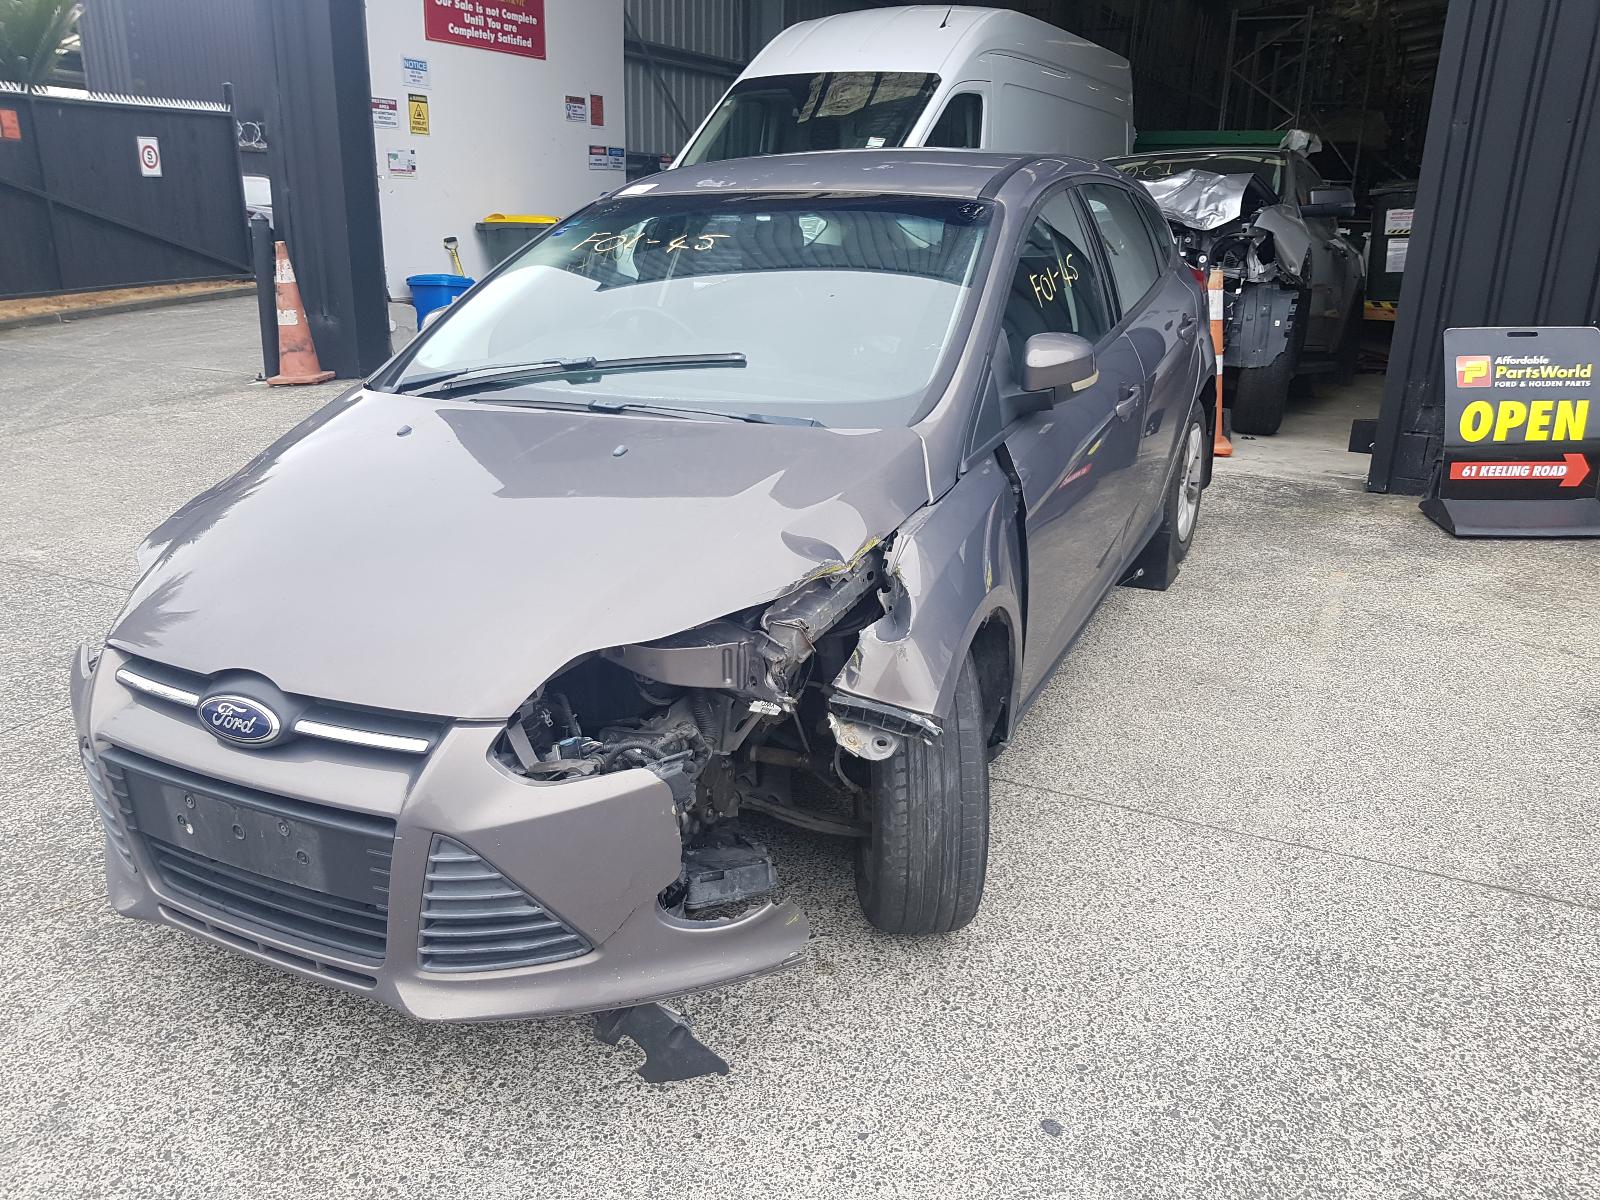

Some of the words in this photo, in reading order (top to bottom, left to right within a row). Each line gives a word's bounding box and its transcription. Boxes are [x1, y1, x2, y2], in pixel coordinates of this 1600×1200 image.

[454, 0, 474, 11] Sale
[476, 2, 483, 13] is
[486, 7, 499, 16] not
[501, 8, 538, 25] Complete
[463, 13, 484, 26] Until
[486, 17, 501, 29] You
[503, 22, 517, 33] are
[447, 22, 496, 43] Completely
[497, 32, 533, 48] Satisfied
[404, 60, 427, 70] NOTICE
[146, 150, 153, 160] 5
[1494, 355, 1550, 365] Affordable
[1495, 363, 1593, 379] PartsWorld
[1494, 380, 1517, 388] FORD
[1529, 380, 1562, 388] HOLDEN
[1565, 380, 1591, 388] PARTS
[1459, 399, 1590, 442] OPEN
[1461, 465, 1477, 477] 61
[1478, 465, 1530, 477] KEELING
[1531, 465, 1567, 477] ROAD
[212, 702, 257, 734] Ford
